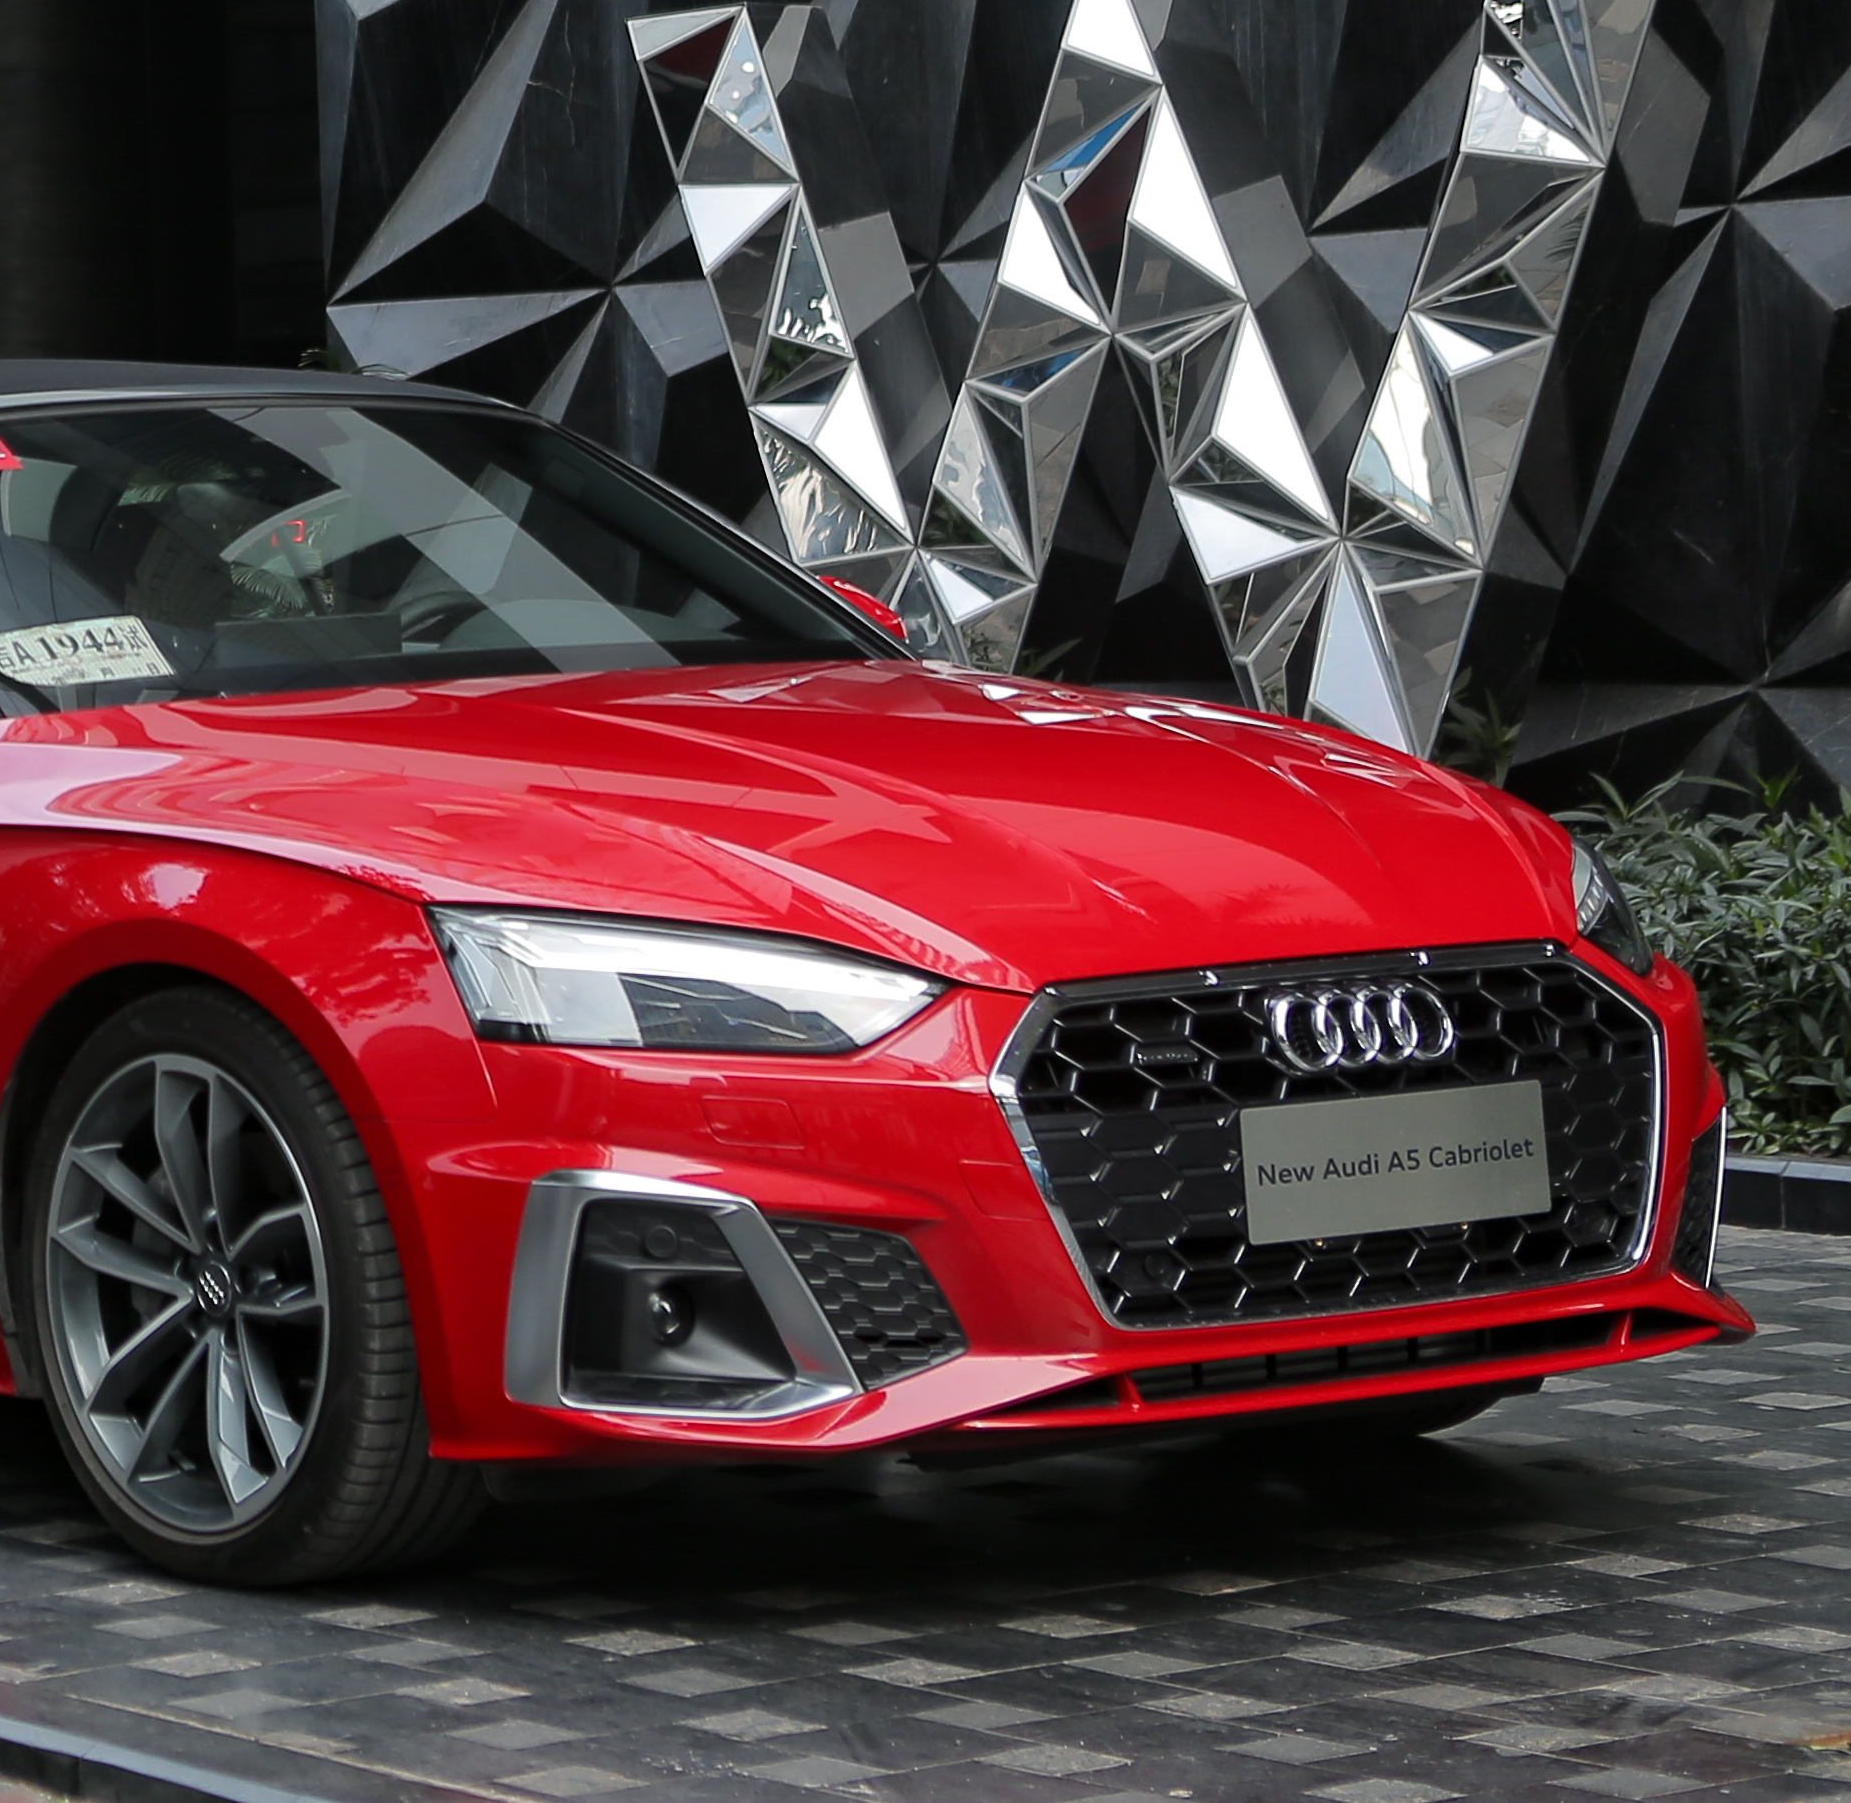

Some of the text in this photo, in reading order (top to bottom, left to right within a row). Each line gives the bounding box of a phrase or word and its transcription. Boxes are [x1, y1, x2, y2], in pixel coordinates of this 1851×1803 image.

[1257, 1138, 1534, 1186] New Audi A5 Cabriolet
